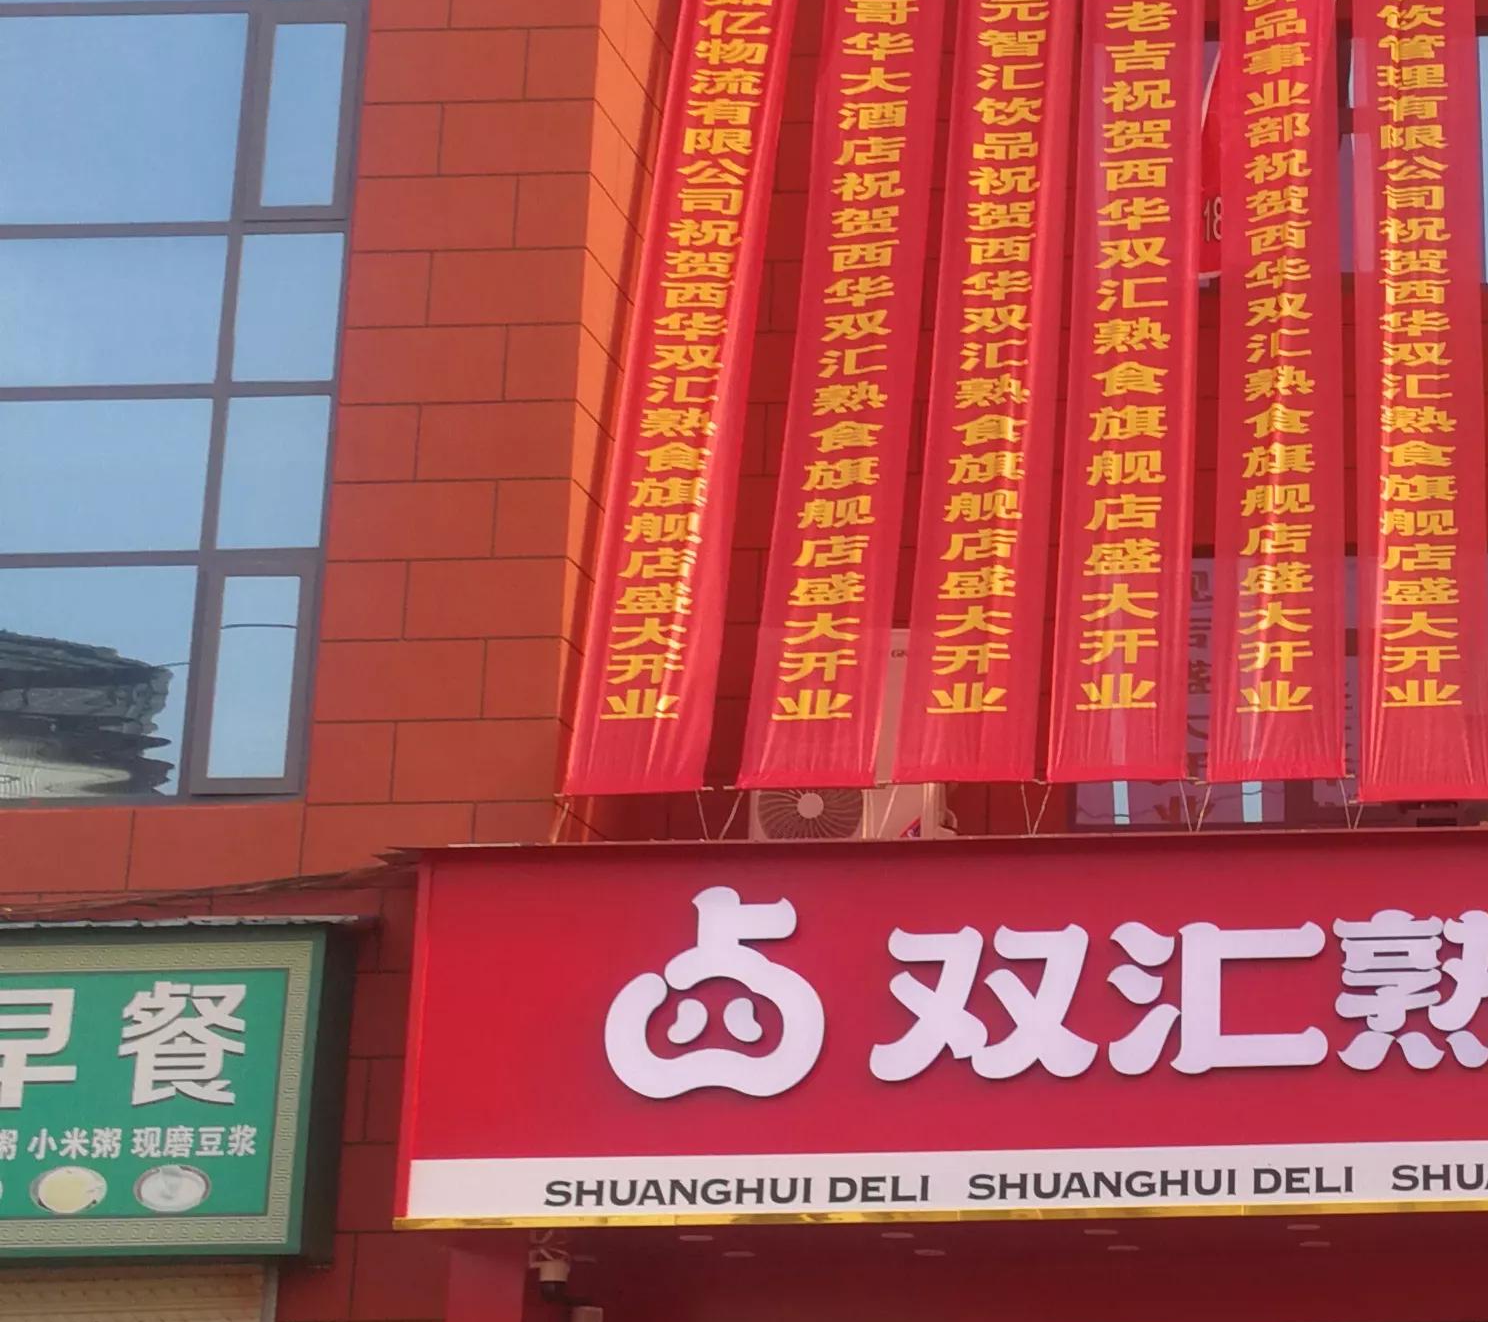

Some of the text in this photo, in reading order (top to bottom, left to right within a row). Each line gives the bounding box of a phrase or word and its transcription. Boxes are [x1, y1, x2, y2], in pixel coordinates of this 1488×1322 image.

[0, 981, 247, 1109] 早餐
[27, 1127, 123, 1161] 小米粥
[130, 1124, 258, 1159] 现磨豆浆
[544, 1176, 812, 1208] SHUANGHUI
[827, 1175, 931, 1204] DELI
[967, 1168, 1238, 1201] SHUANGHUI
[1251, 1166, 1354, 1196] DELI
